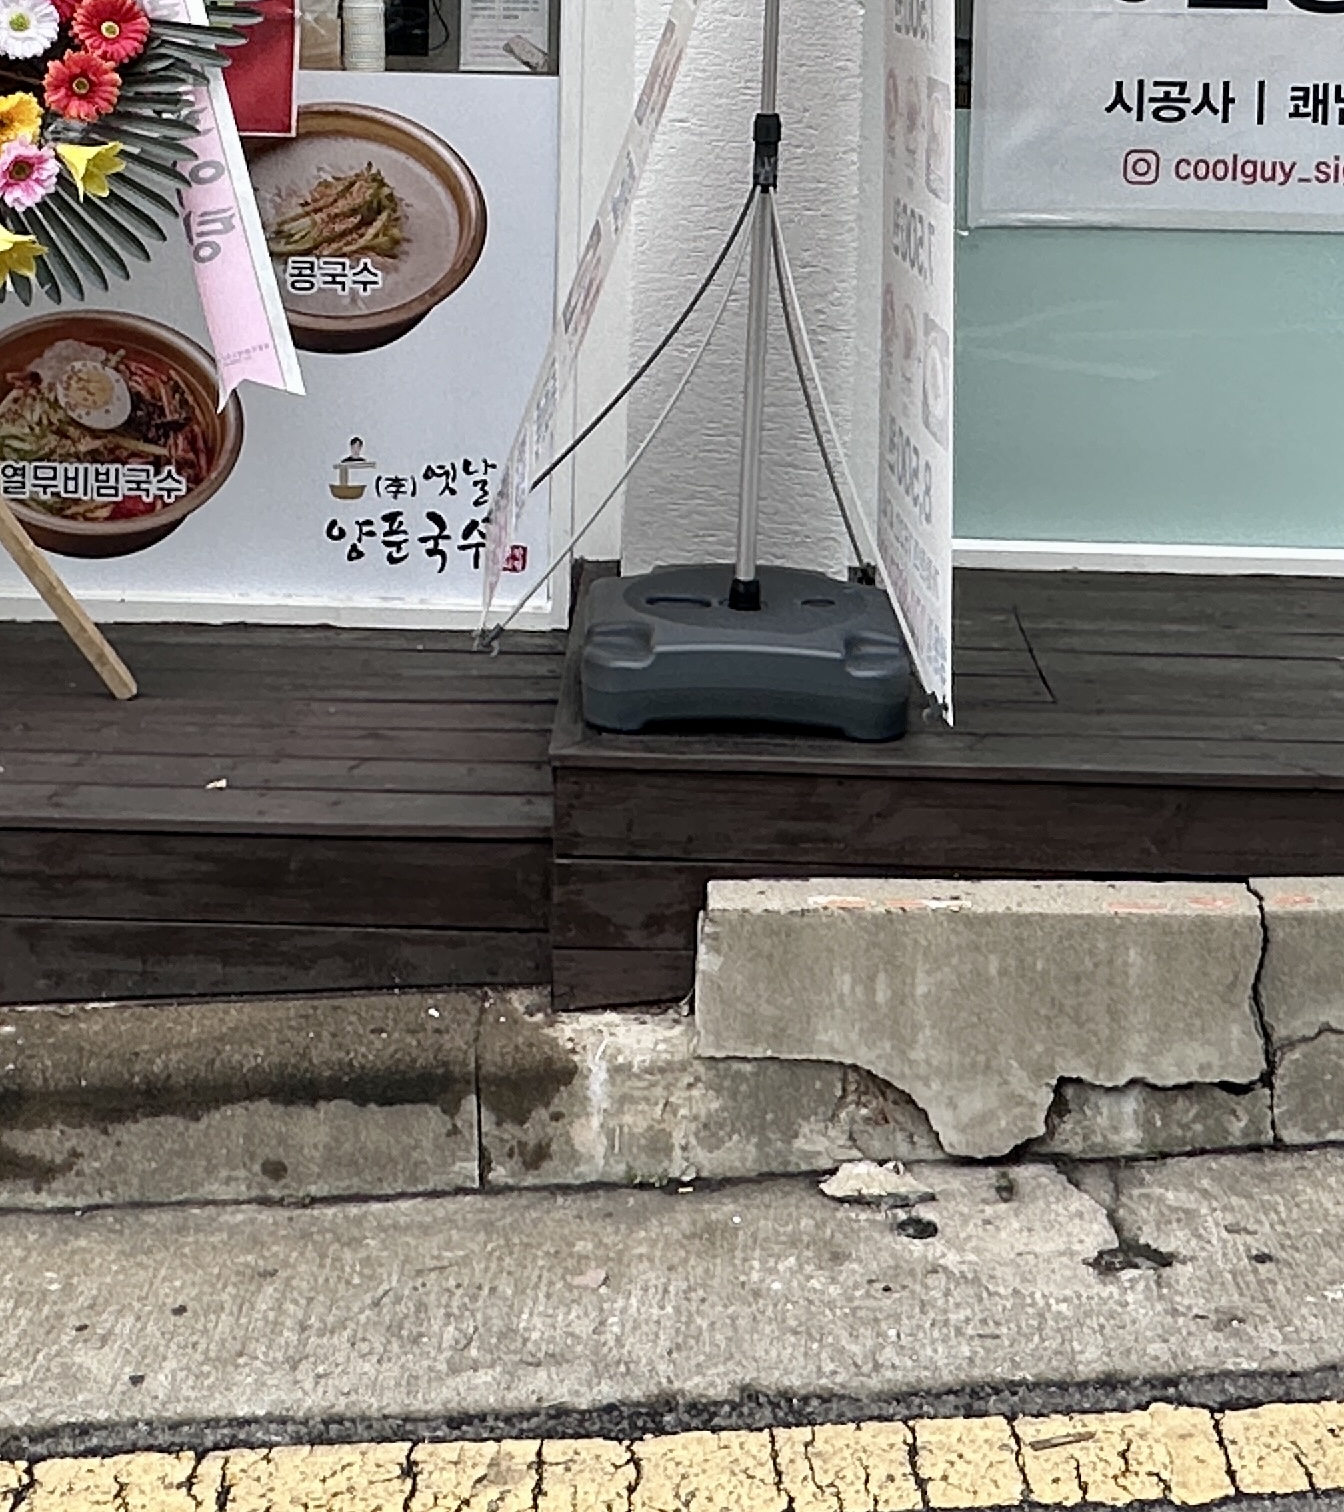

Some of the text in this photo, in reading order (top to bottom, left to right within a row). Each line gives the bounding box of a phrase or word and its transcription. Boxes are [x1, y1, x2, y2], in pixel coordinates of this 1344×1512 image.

[1104, 78, 1237, 126] 시공사
[285, 257, 383, 296] 콩국수
[0, 463, 189, 501] 열무비빔국수
